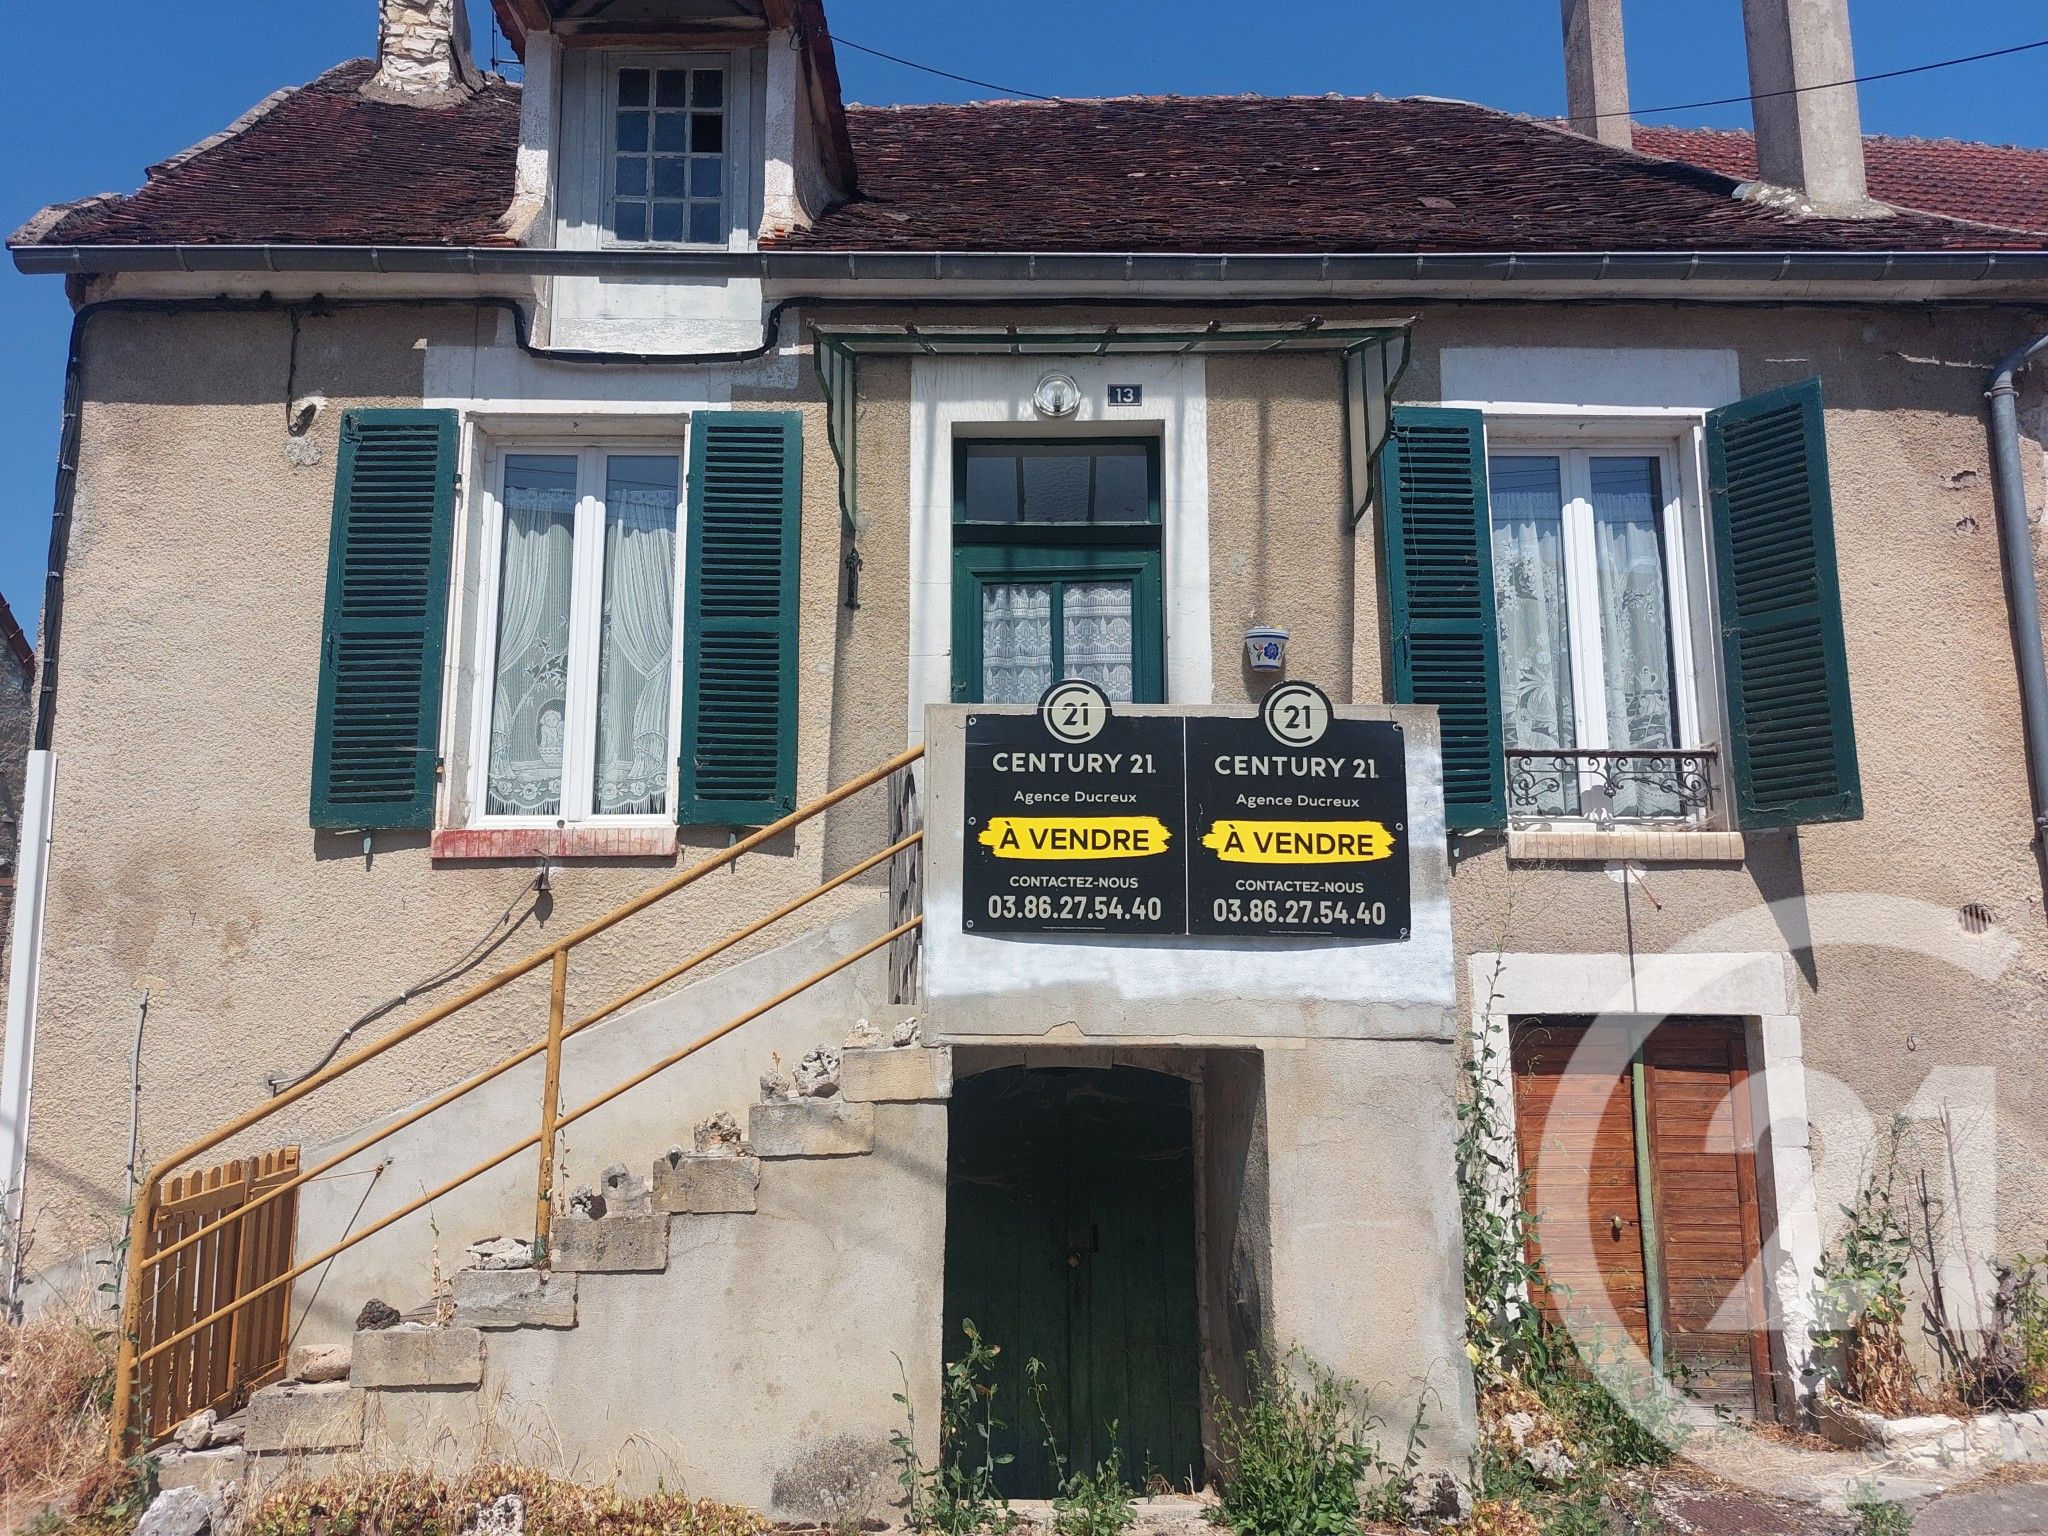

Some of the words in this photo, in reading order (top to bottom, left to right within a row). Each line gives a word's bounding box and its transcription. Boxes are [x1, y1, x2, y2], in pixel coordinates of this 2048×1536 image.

[1115, 388, 1134, 402] 13
[992, 753, 1122, 773] CENTURY
[1214, 756, 1346, 778] CENTURY
[1014, 790, 1070, 805] Agence
[1075, 791, 1137, 803] Ducreux
[1236, 794, 1292, 809] Agence
[1298, 795, 1359, 808] Ducreux
[999, 821, 1020, 849] À
[1029, 829, 1150, 851] VENDRE
[1224, 824, 1244, 853] À
[1253, 832, 1374, 856] VENDRE
[1010, 876, 1138, 888] CONTACTEZ-NOUS
[1235, 880, 1364, 893] CONTACTEZ-NOUS
[988, 895, 1161, 920] 03.86.27.54.40
[1213, 899, 1385, 925] 03.86.27.54.40
